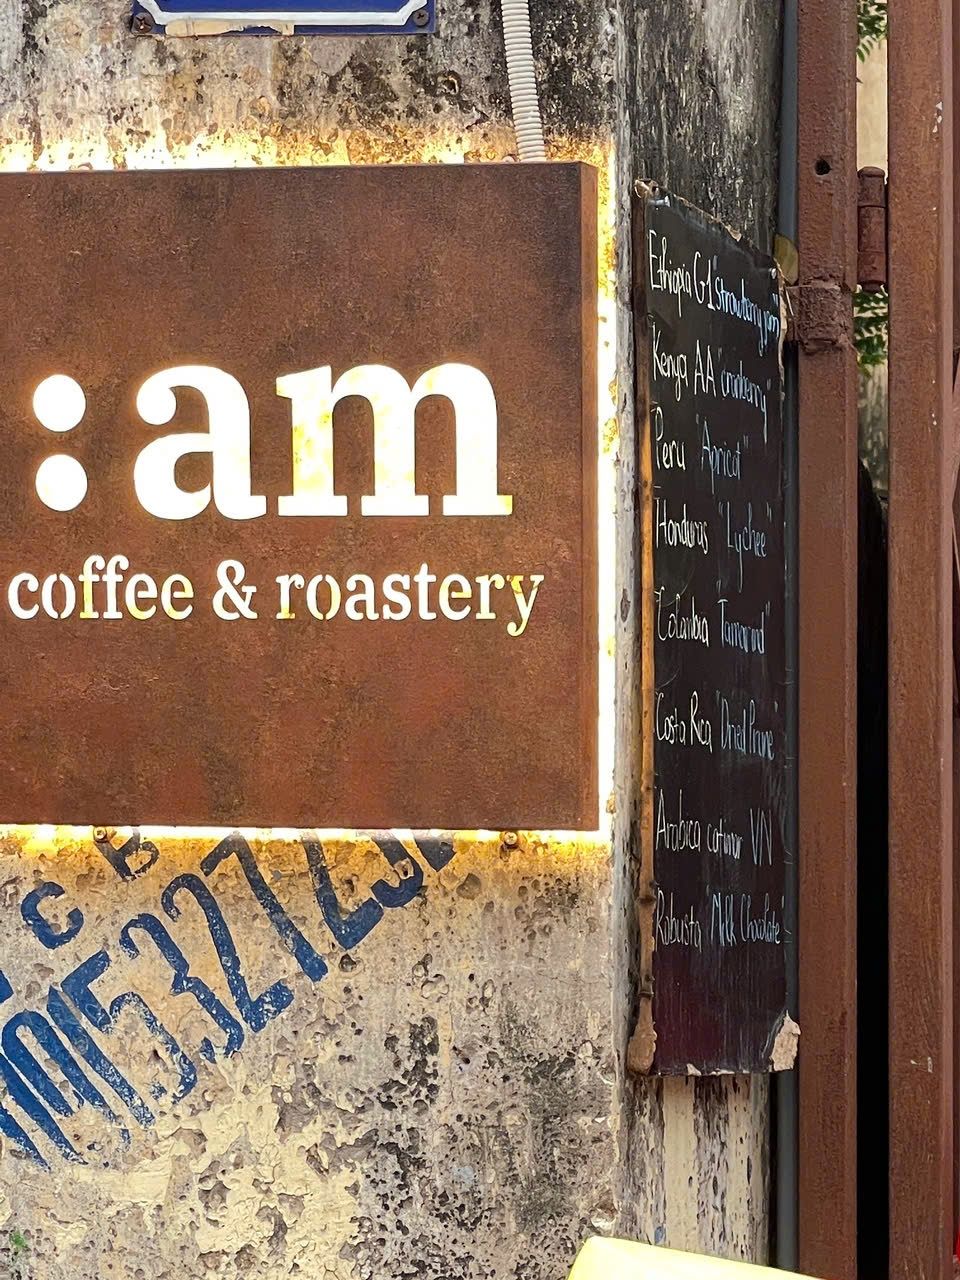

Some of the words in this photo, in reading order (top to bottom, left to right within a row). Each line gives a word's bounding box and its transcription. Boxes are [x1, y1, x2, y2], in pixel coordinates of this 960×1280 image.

[648, 229, 692, 318] Ethiopia
[652, 321, 688, 402] Kenya
[694, 339, 716, 398] AA
[655, 406, 686, 471] Peru
[655, 497, 709, 555] Honduras
[8, 554, 195, 622] coffee
[213, 559, 258, 621] &
[275, 562, 546, 637] roastery
[656, 692, 686, 746] Costa
[690, 690, 713, 754] Rica
[655, 788, 701, 852] Arabica
[749, 807, 773, 867] VN
[655, 886, 702, 953] Robusta
